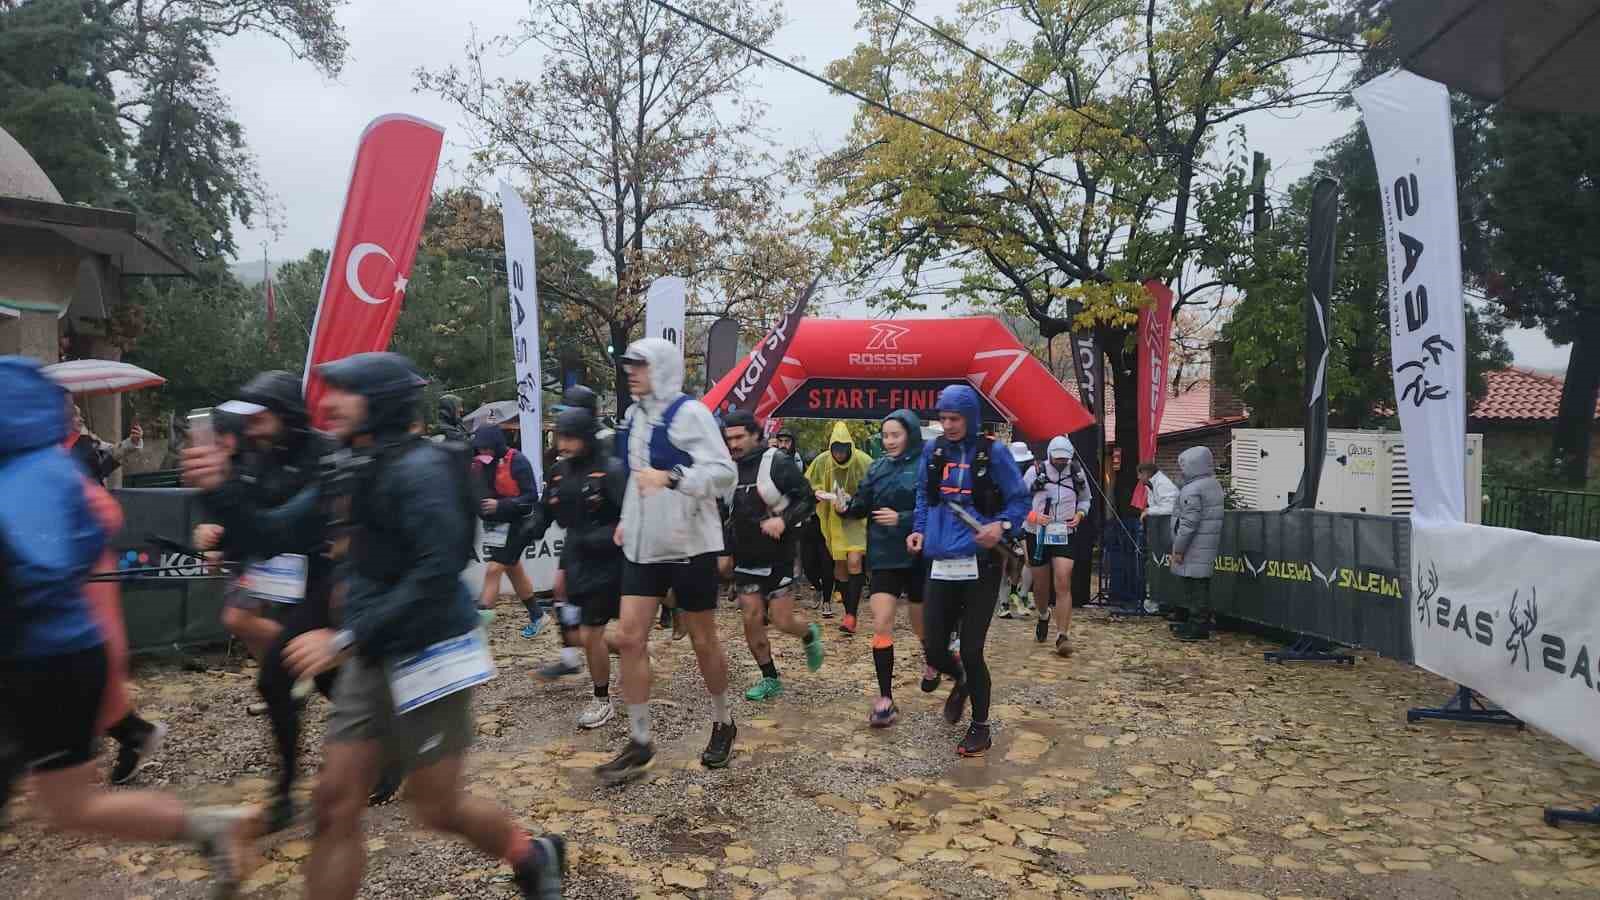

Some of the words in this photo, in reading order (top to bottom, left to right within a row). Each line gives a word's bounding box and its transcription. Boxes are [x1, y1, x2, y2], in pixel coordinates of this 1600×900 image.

[848, 353, 922, 366] ROSSIST
[808, 387, 942, 409] START-FINI
[1266, 560, 1313, 583] SALEWA
[1338, 567, 1403, 600] SALEWA
[1541, 633, 1600, 693] 2A
